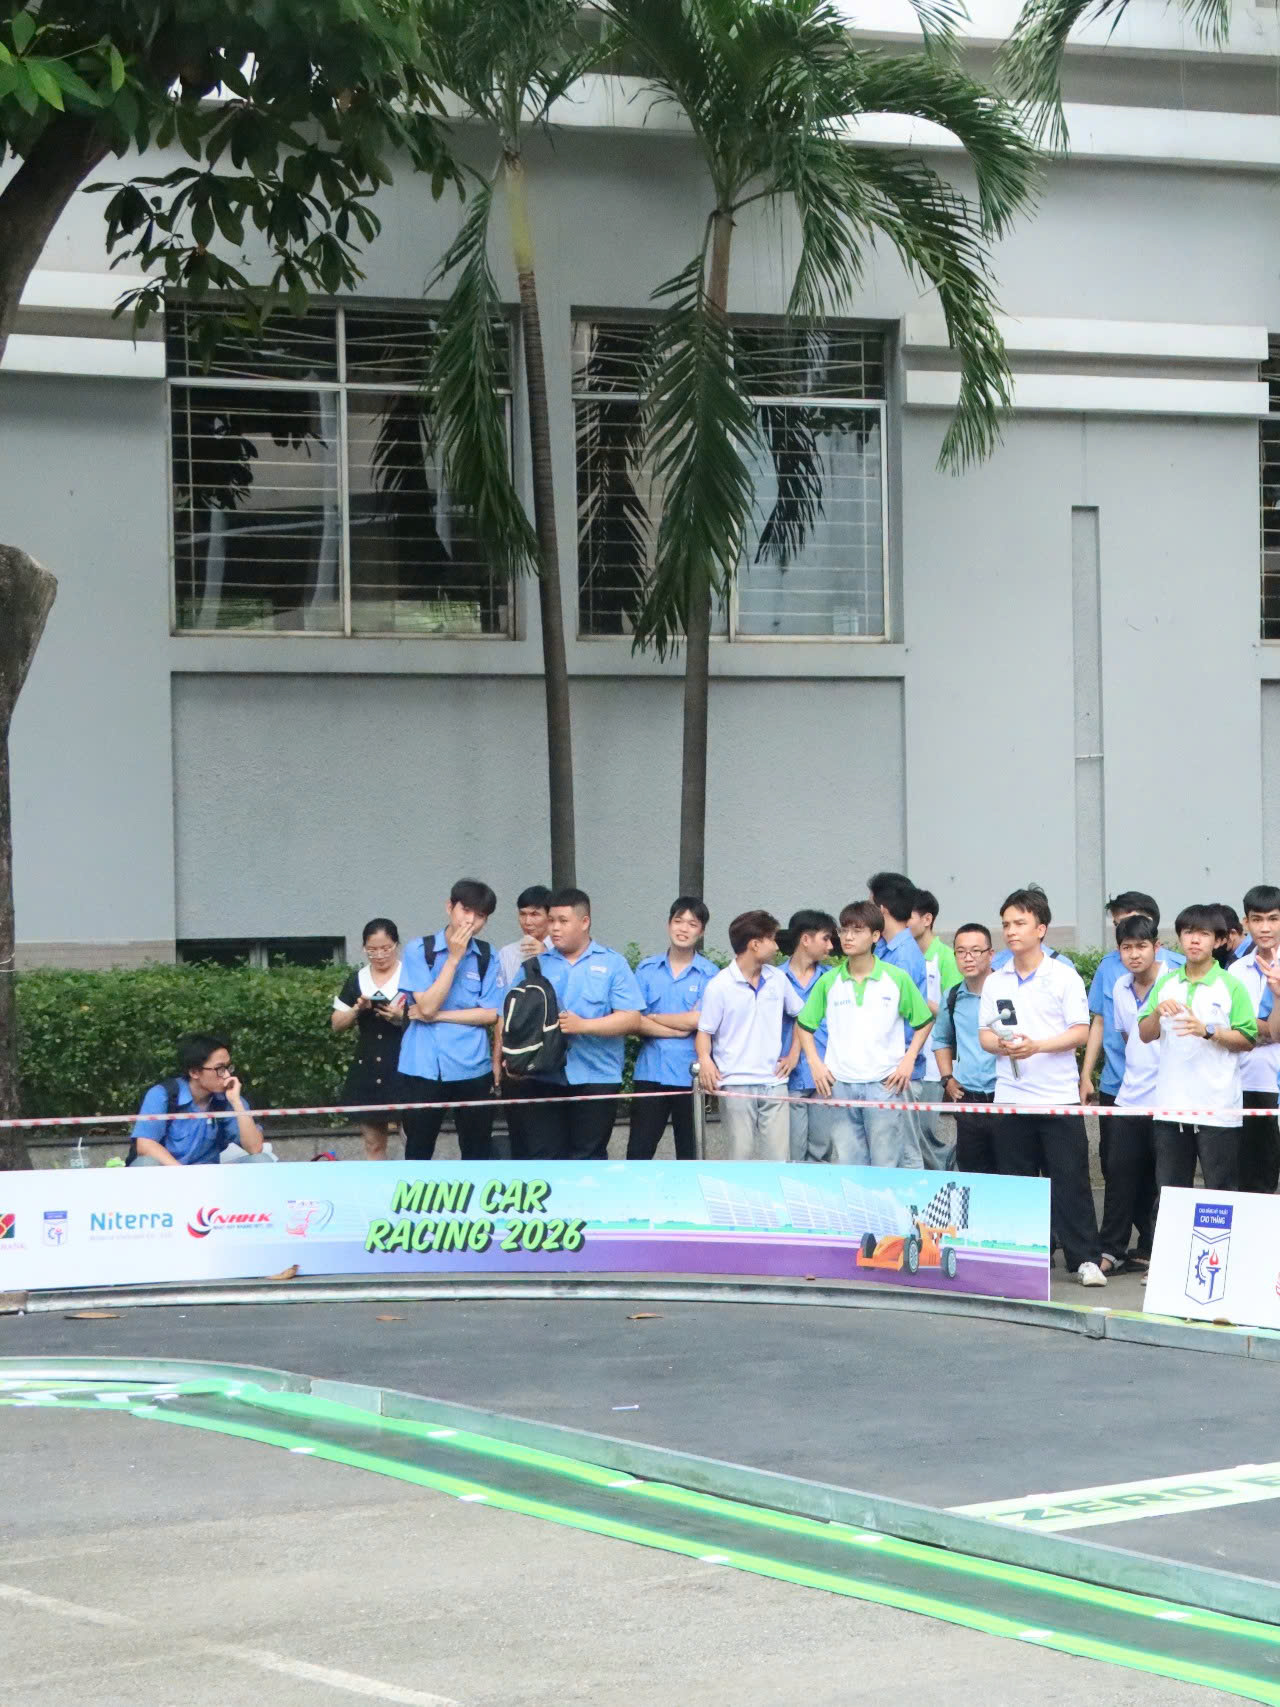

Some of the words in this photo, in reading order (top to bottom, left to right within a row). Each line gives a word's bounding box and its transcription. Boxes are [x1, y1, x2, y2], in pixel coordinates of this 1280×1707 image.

[391, 1178, 475, 1214] MINI
[479, 1178, 552, 1214] CAR
[91, 1212, 173, 1231] Niterra
[364, 1217, 495, 1254] RACING
[500, 1217, 588, 1254] 2026
[996, 1484, 1233, 1521] ZERO
